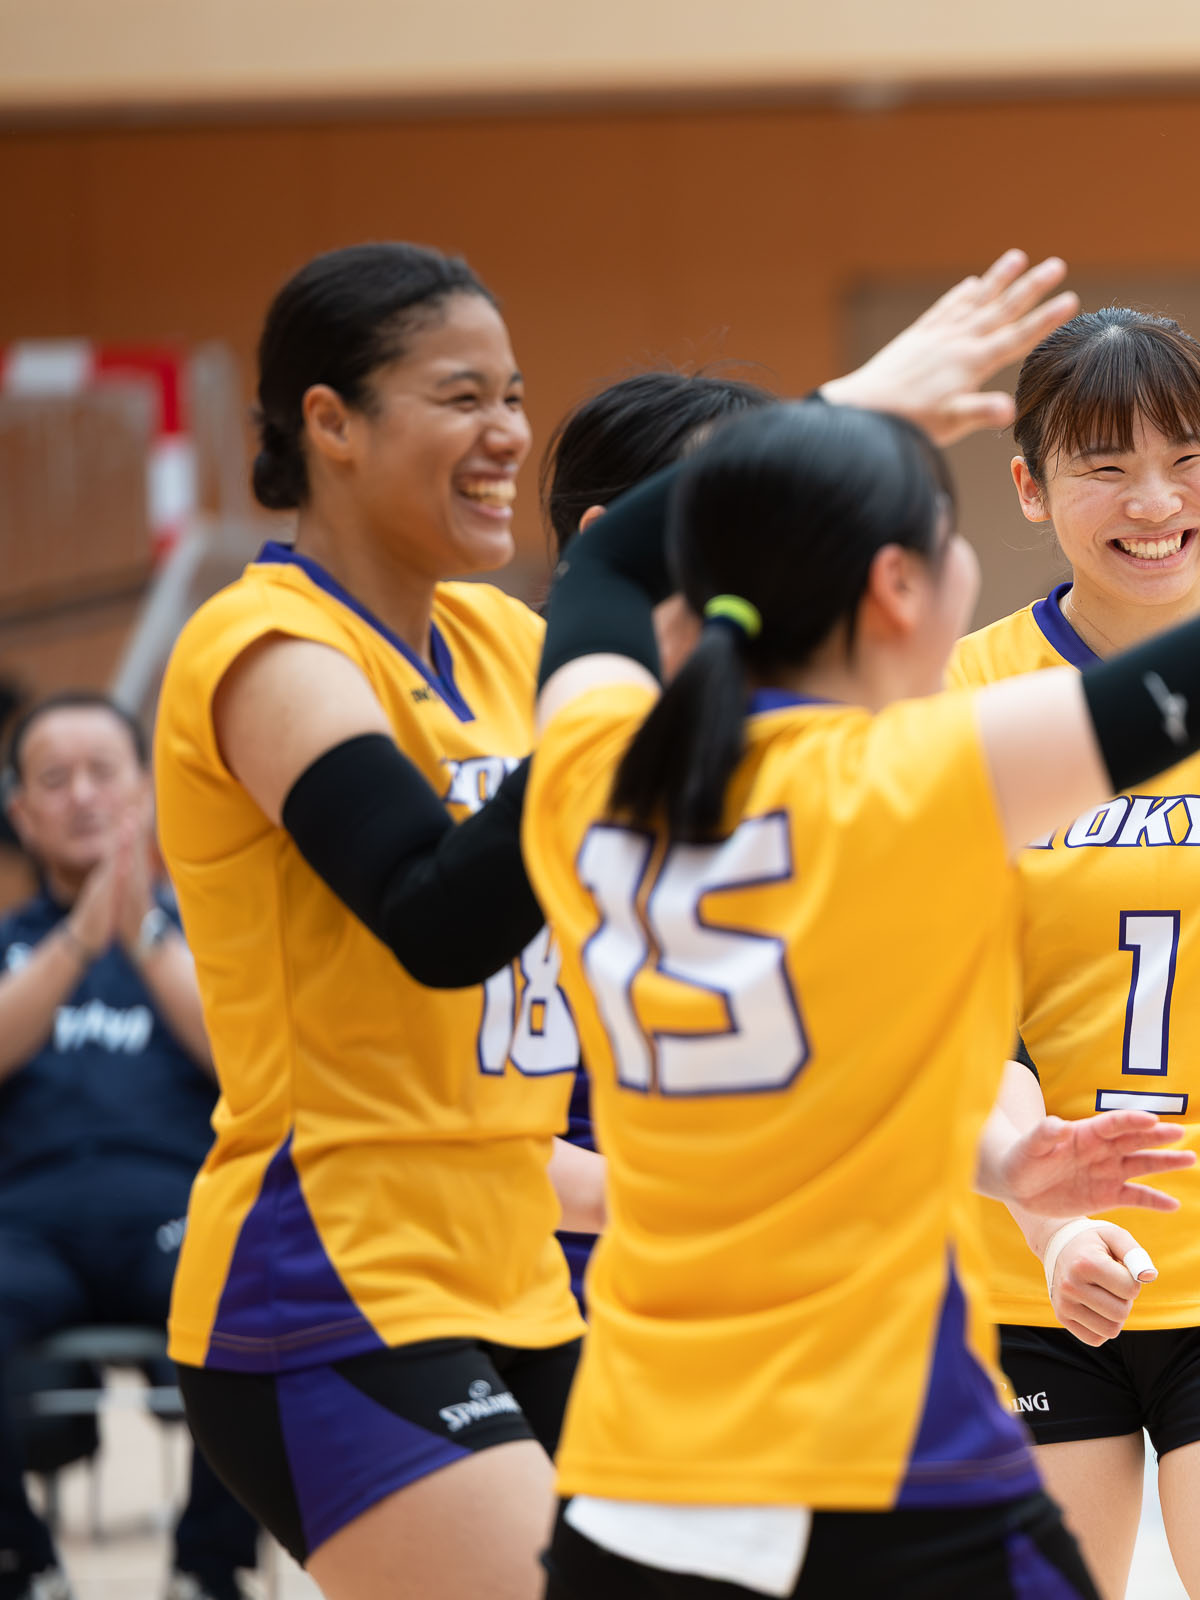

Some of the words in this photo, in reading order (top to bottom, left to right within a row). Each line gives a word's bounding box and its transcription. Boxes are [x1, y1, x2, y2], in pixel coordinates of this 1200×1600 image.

[476, 922, 581, 1077] 18
[577, 810, 811, 1097] 15
[1118, 910, 1181, 1076] 1
